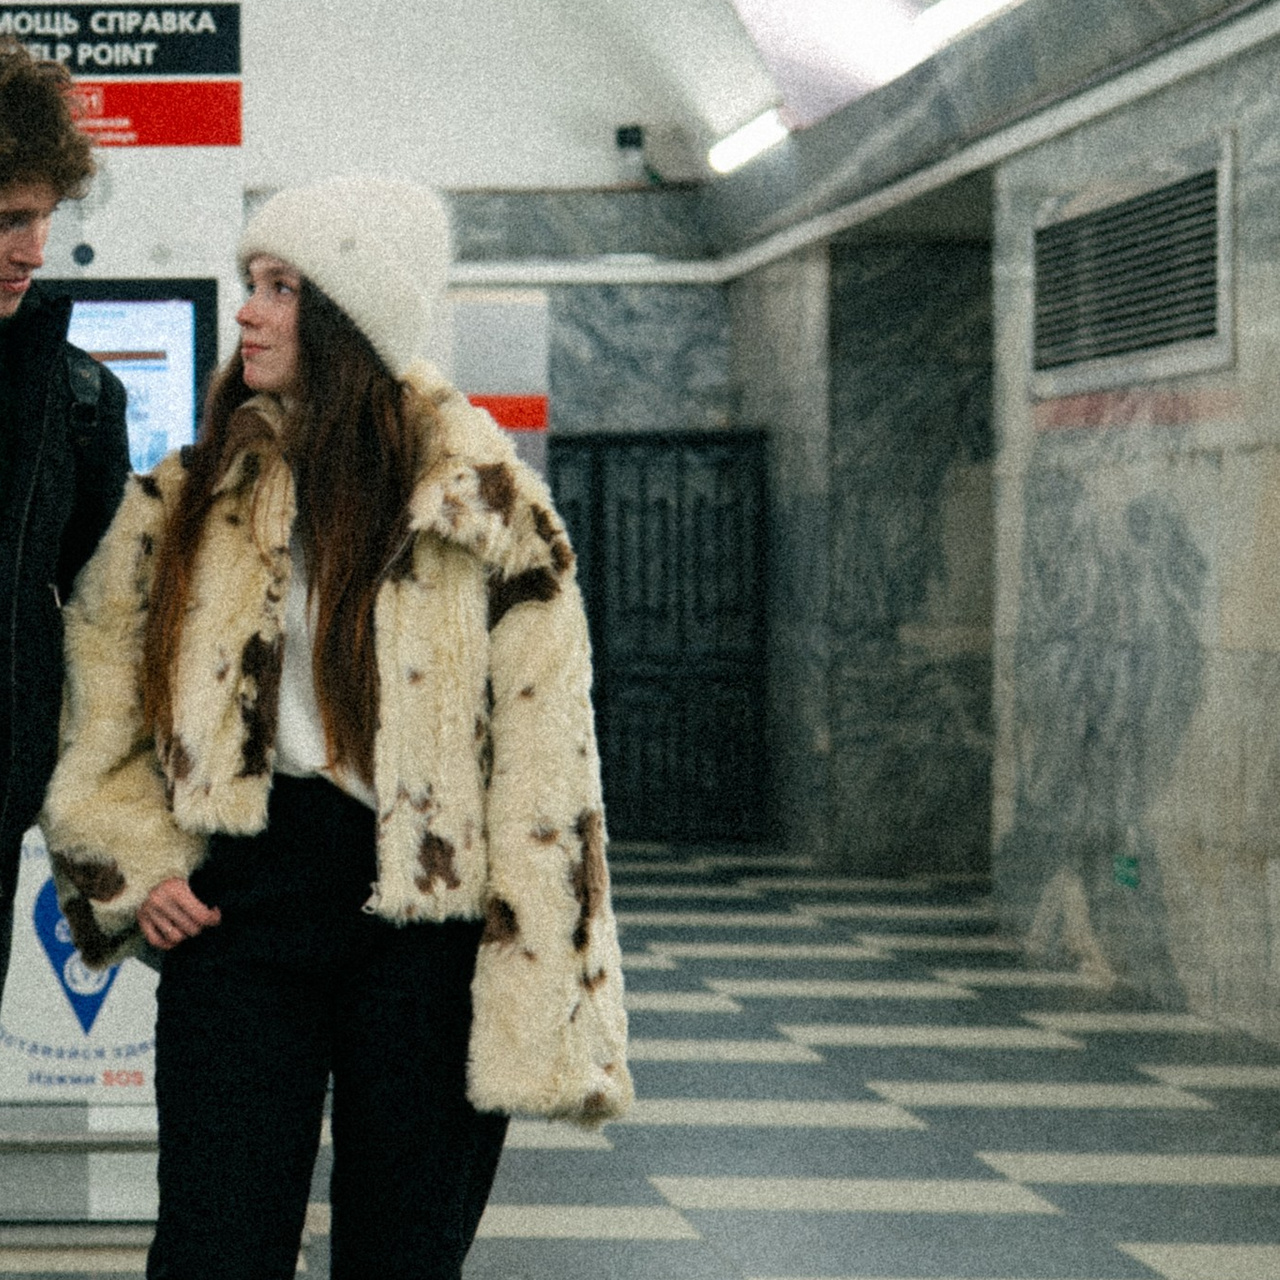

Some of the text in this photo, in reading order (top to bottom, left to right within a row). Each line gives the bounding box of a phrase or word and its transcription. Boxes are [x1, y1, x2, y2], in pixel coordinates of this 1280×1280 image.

[89, 10, 217, 35] СПРАВКА
[18, 42, 158, 67] ELP POINT
[101, 1068, 145, 1088] SOS
